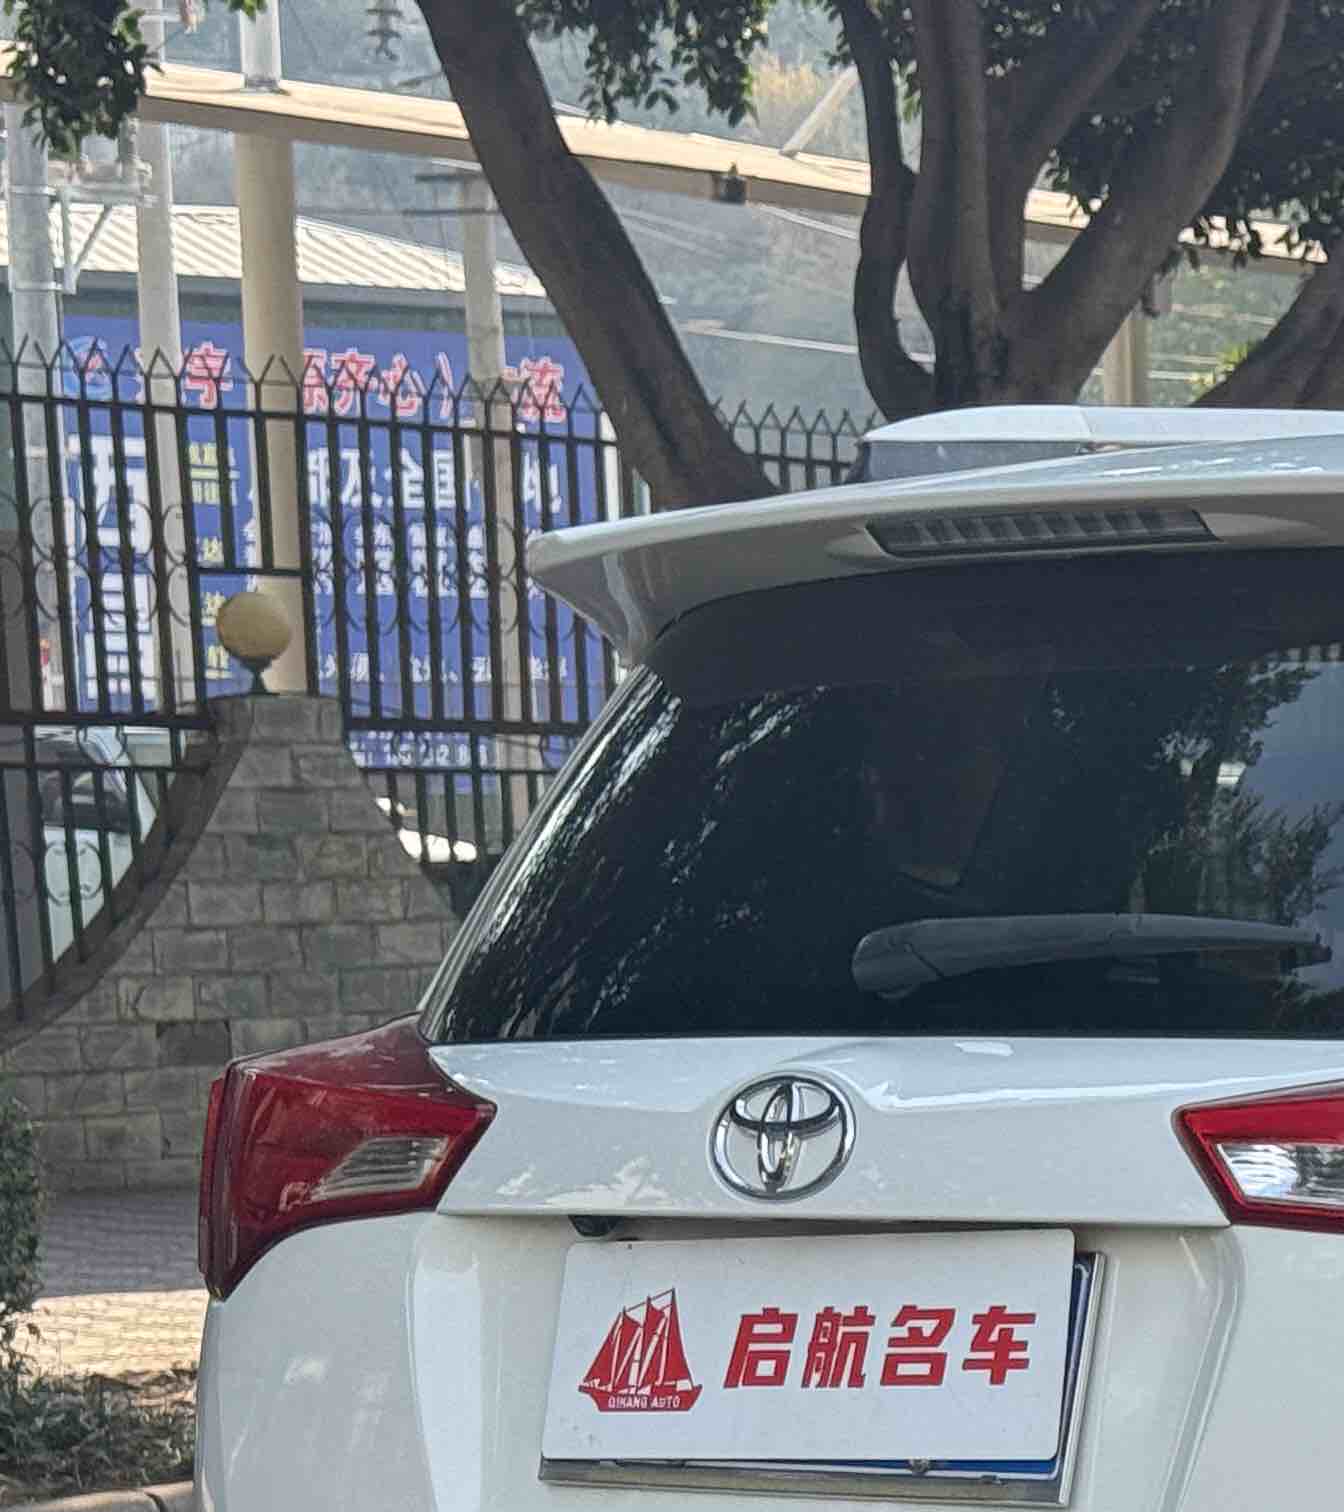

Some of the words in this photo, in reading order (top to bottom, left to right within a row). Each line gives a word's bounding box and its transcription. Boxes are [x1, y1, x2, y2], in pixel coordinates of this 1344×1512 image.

[723, 1304, 1037, 1389] 启航名车
[650, 1395, 681, 1409] AUTO
